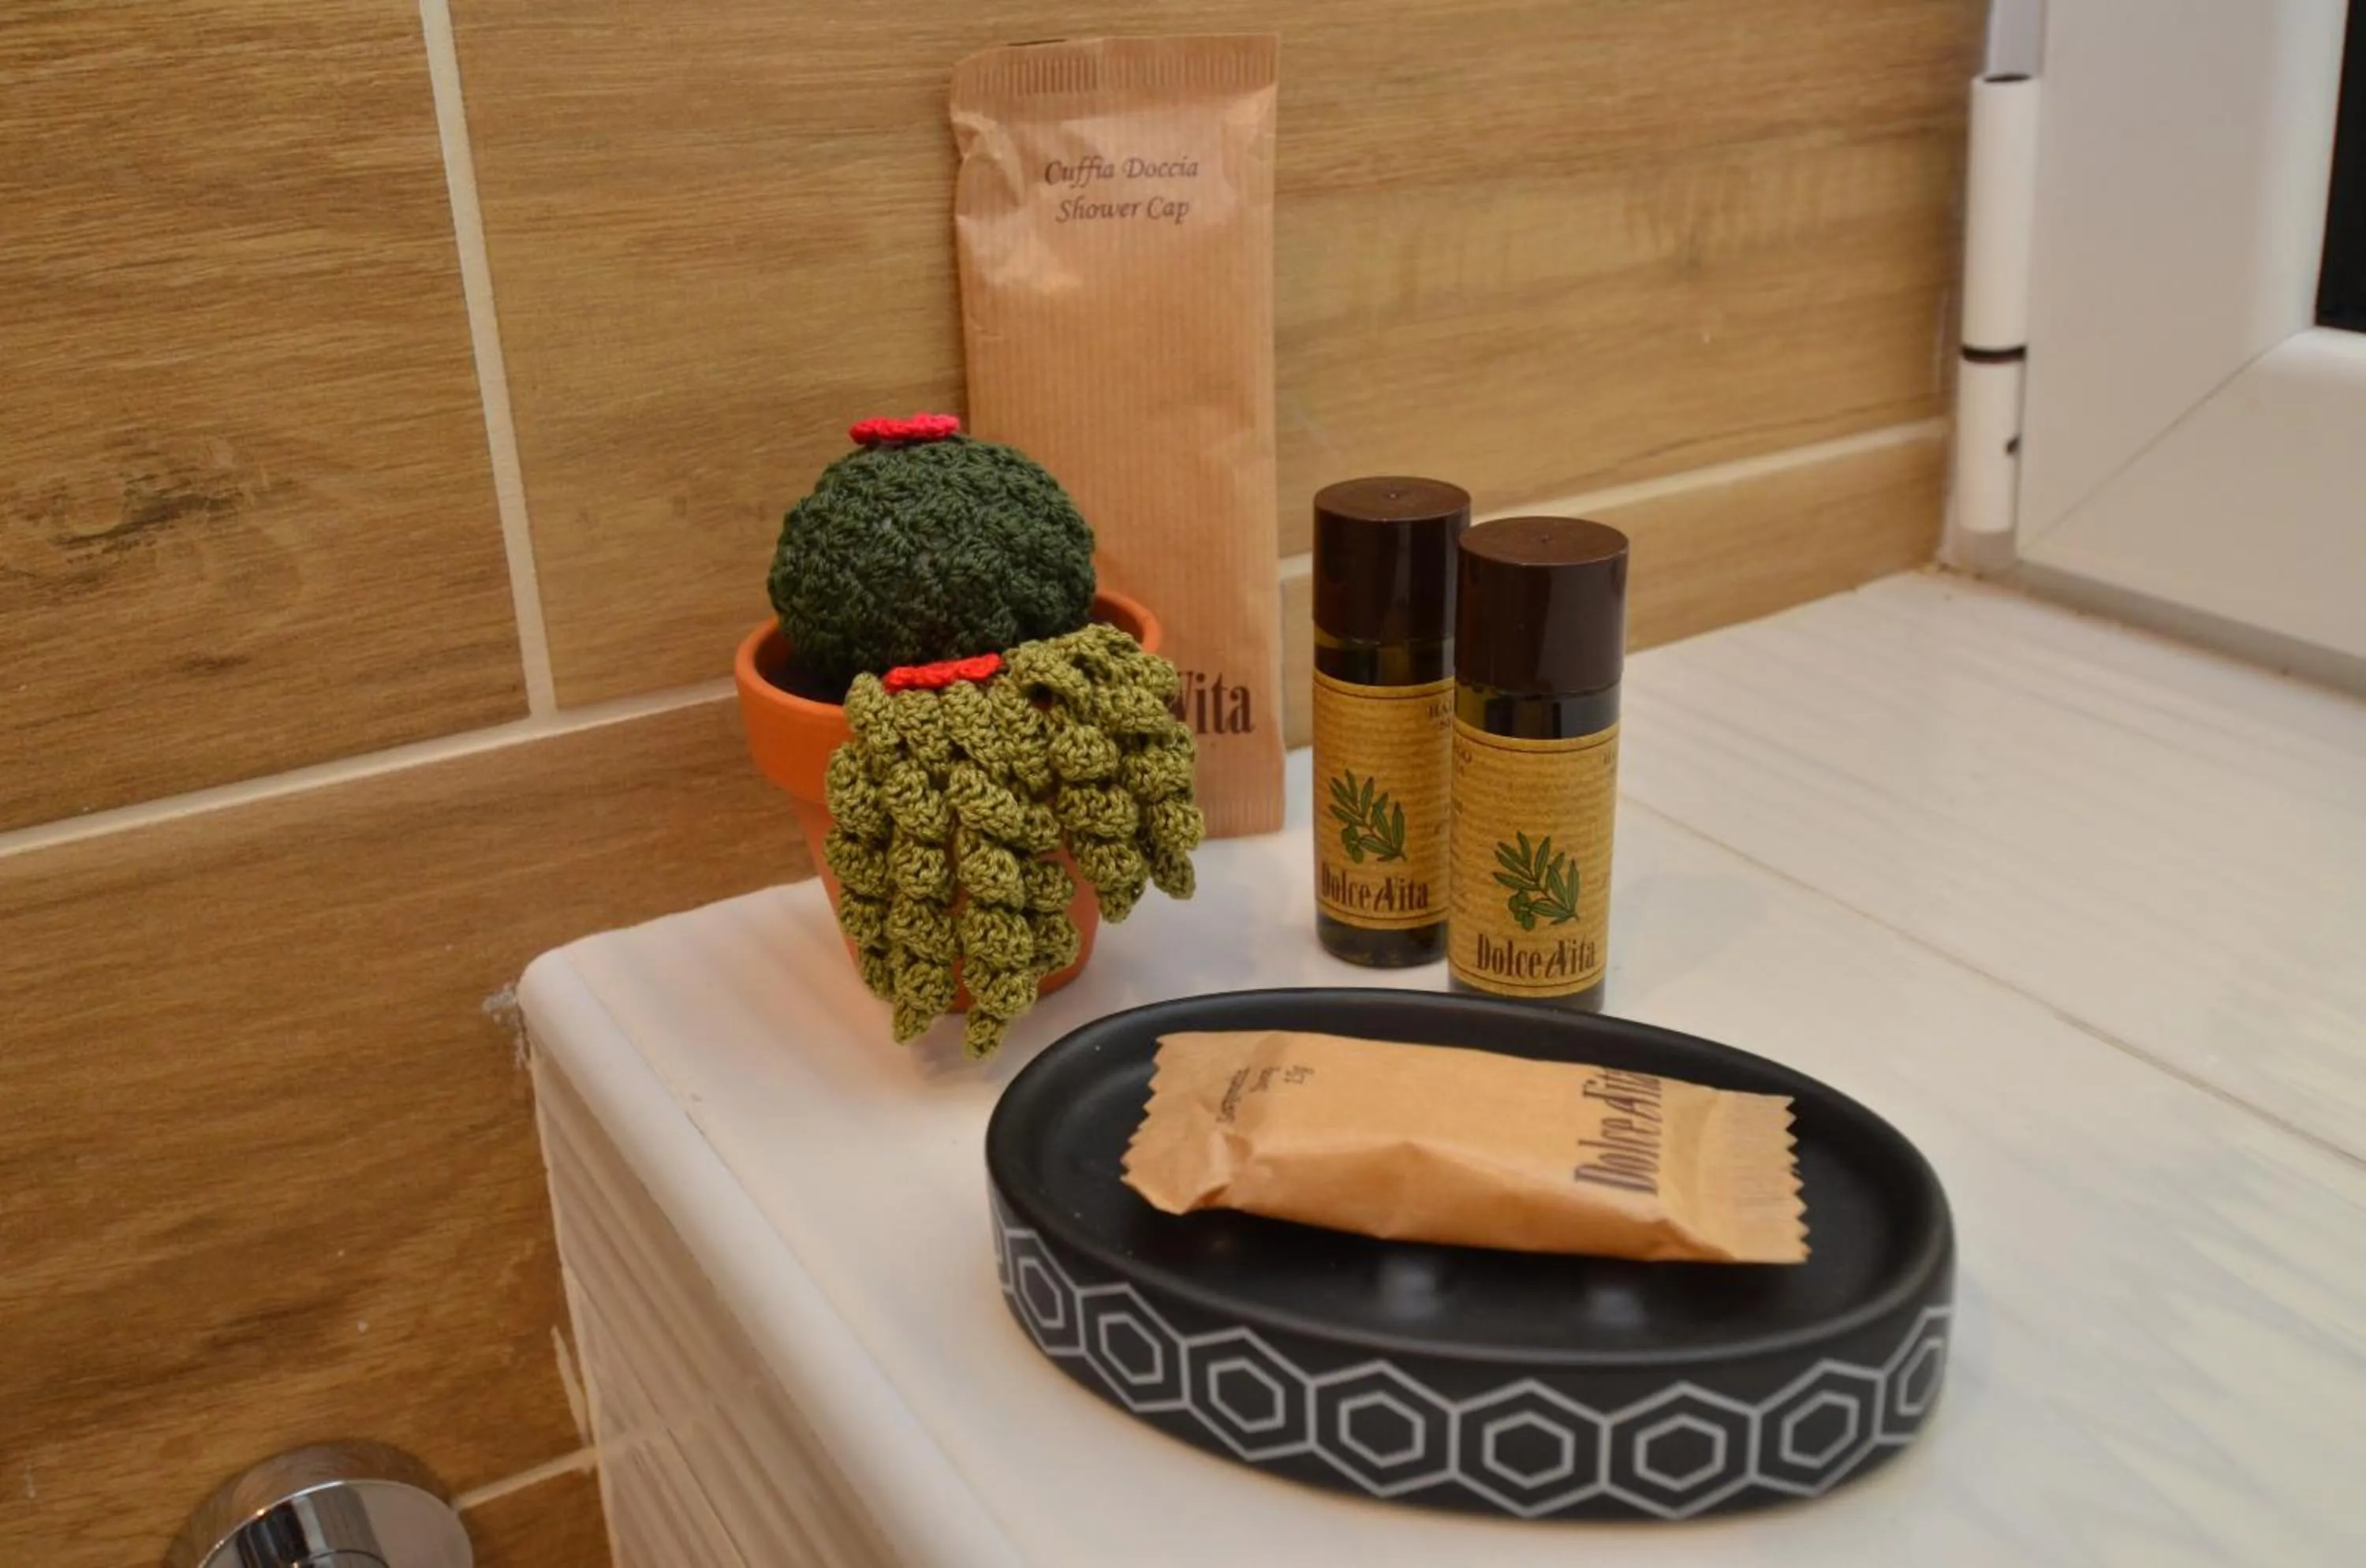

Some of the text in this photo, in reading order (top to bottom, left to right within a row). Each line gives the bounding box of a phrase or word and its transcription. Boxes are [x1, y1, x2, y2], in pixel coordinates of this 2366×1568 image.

[1045, 156, 1199, 189] Cuffia Doccia
[1055, 196, 1190, 225] Shower Cap
